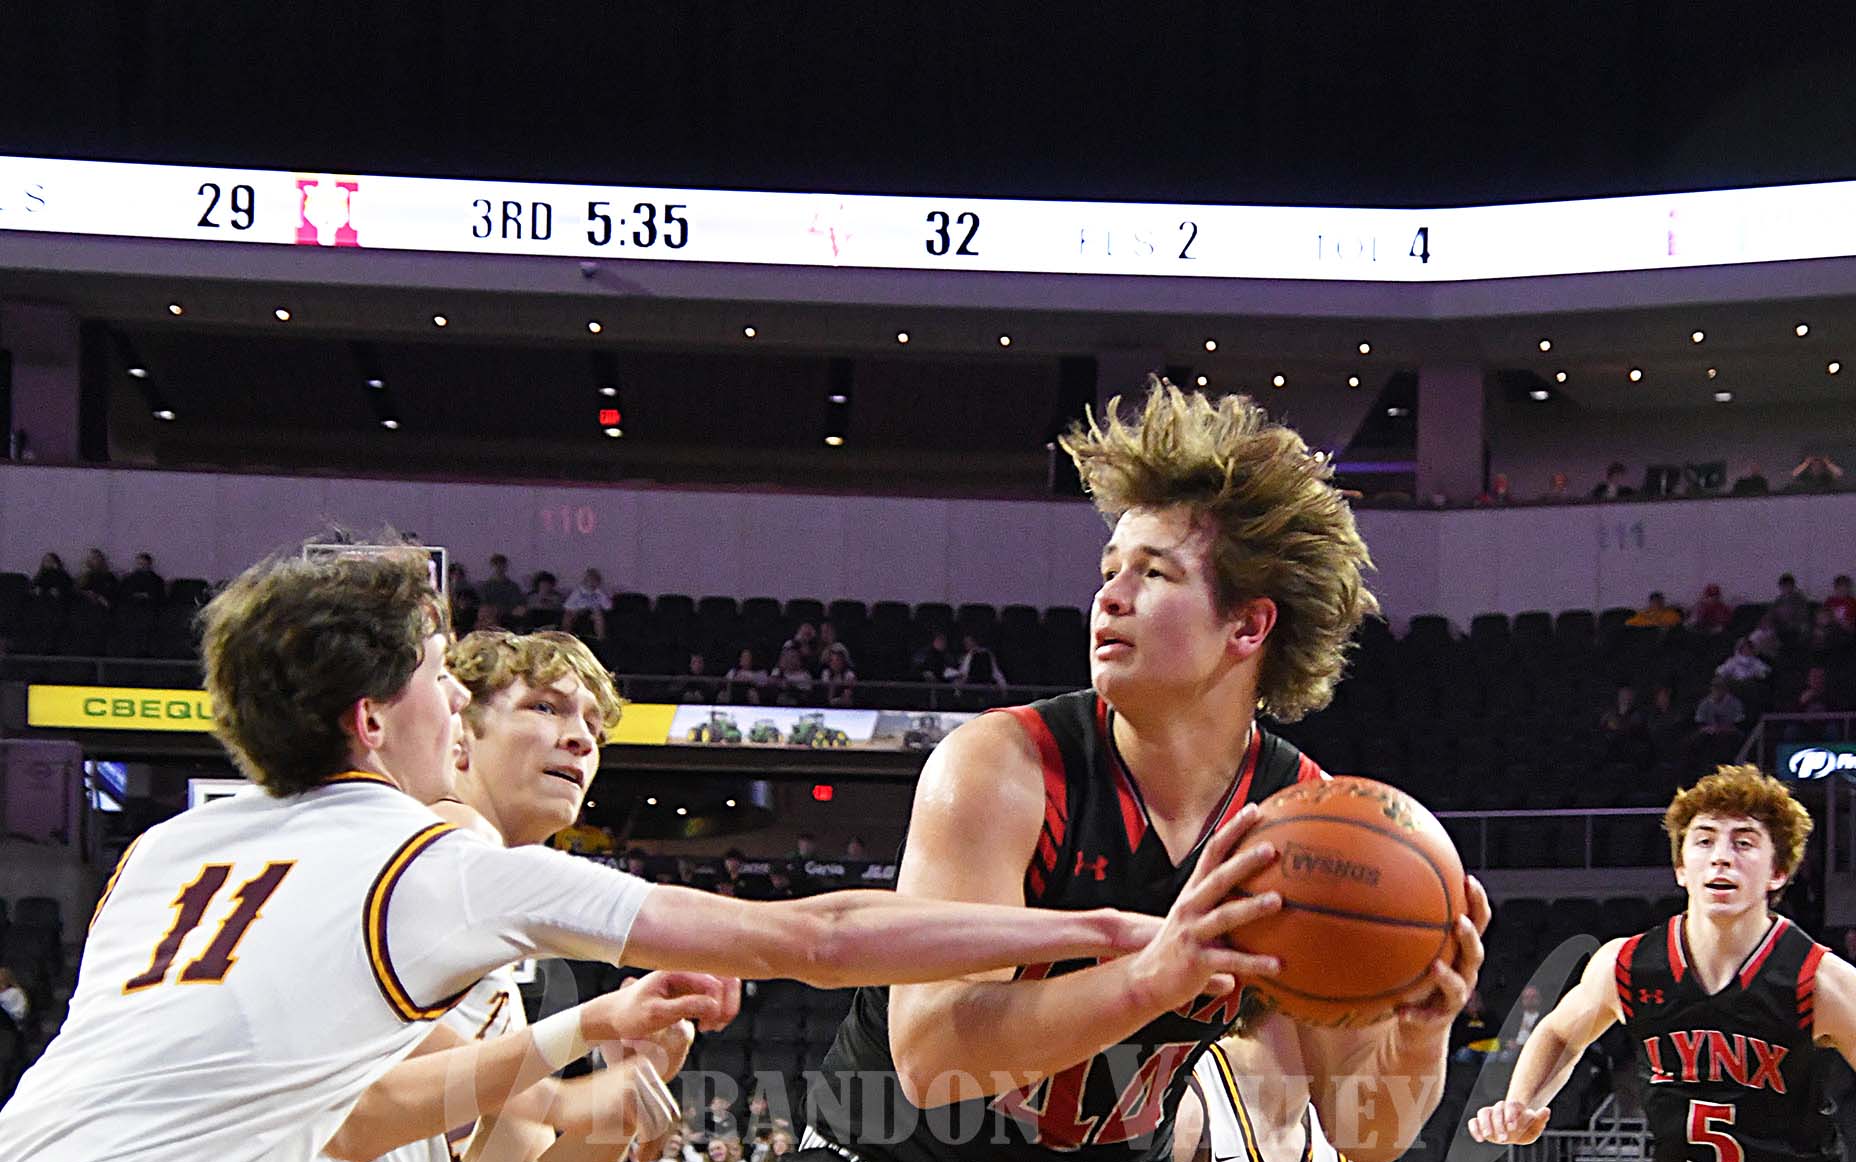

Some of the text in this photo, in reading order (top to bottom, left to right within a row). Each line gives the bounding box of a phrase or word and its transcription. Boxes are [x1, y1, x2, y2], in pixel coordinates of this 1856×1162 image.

[198, 183, 256, 230] 29
[472, 199, 690, 249] 3RD 5:35
[925, 211, 980, 256] 32
[1178, 221, 1199, 259] 2
[1408, 227, 1431, 264] 4
[83, 697, 212, 720] CBEQU
[121, 860, 298, 996] 11
[1643, 1029, 1789, 1095] LYNX
[987, 1040, 1201, 1152] 44
